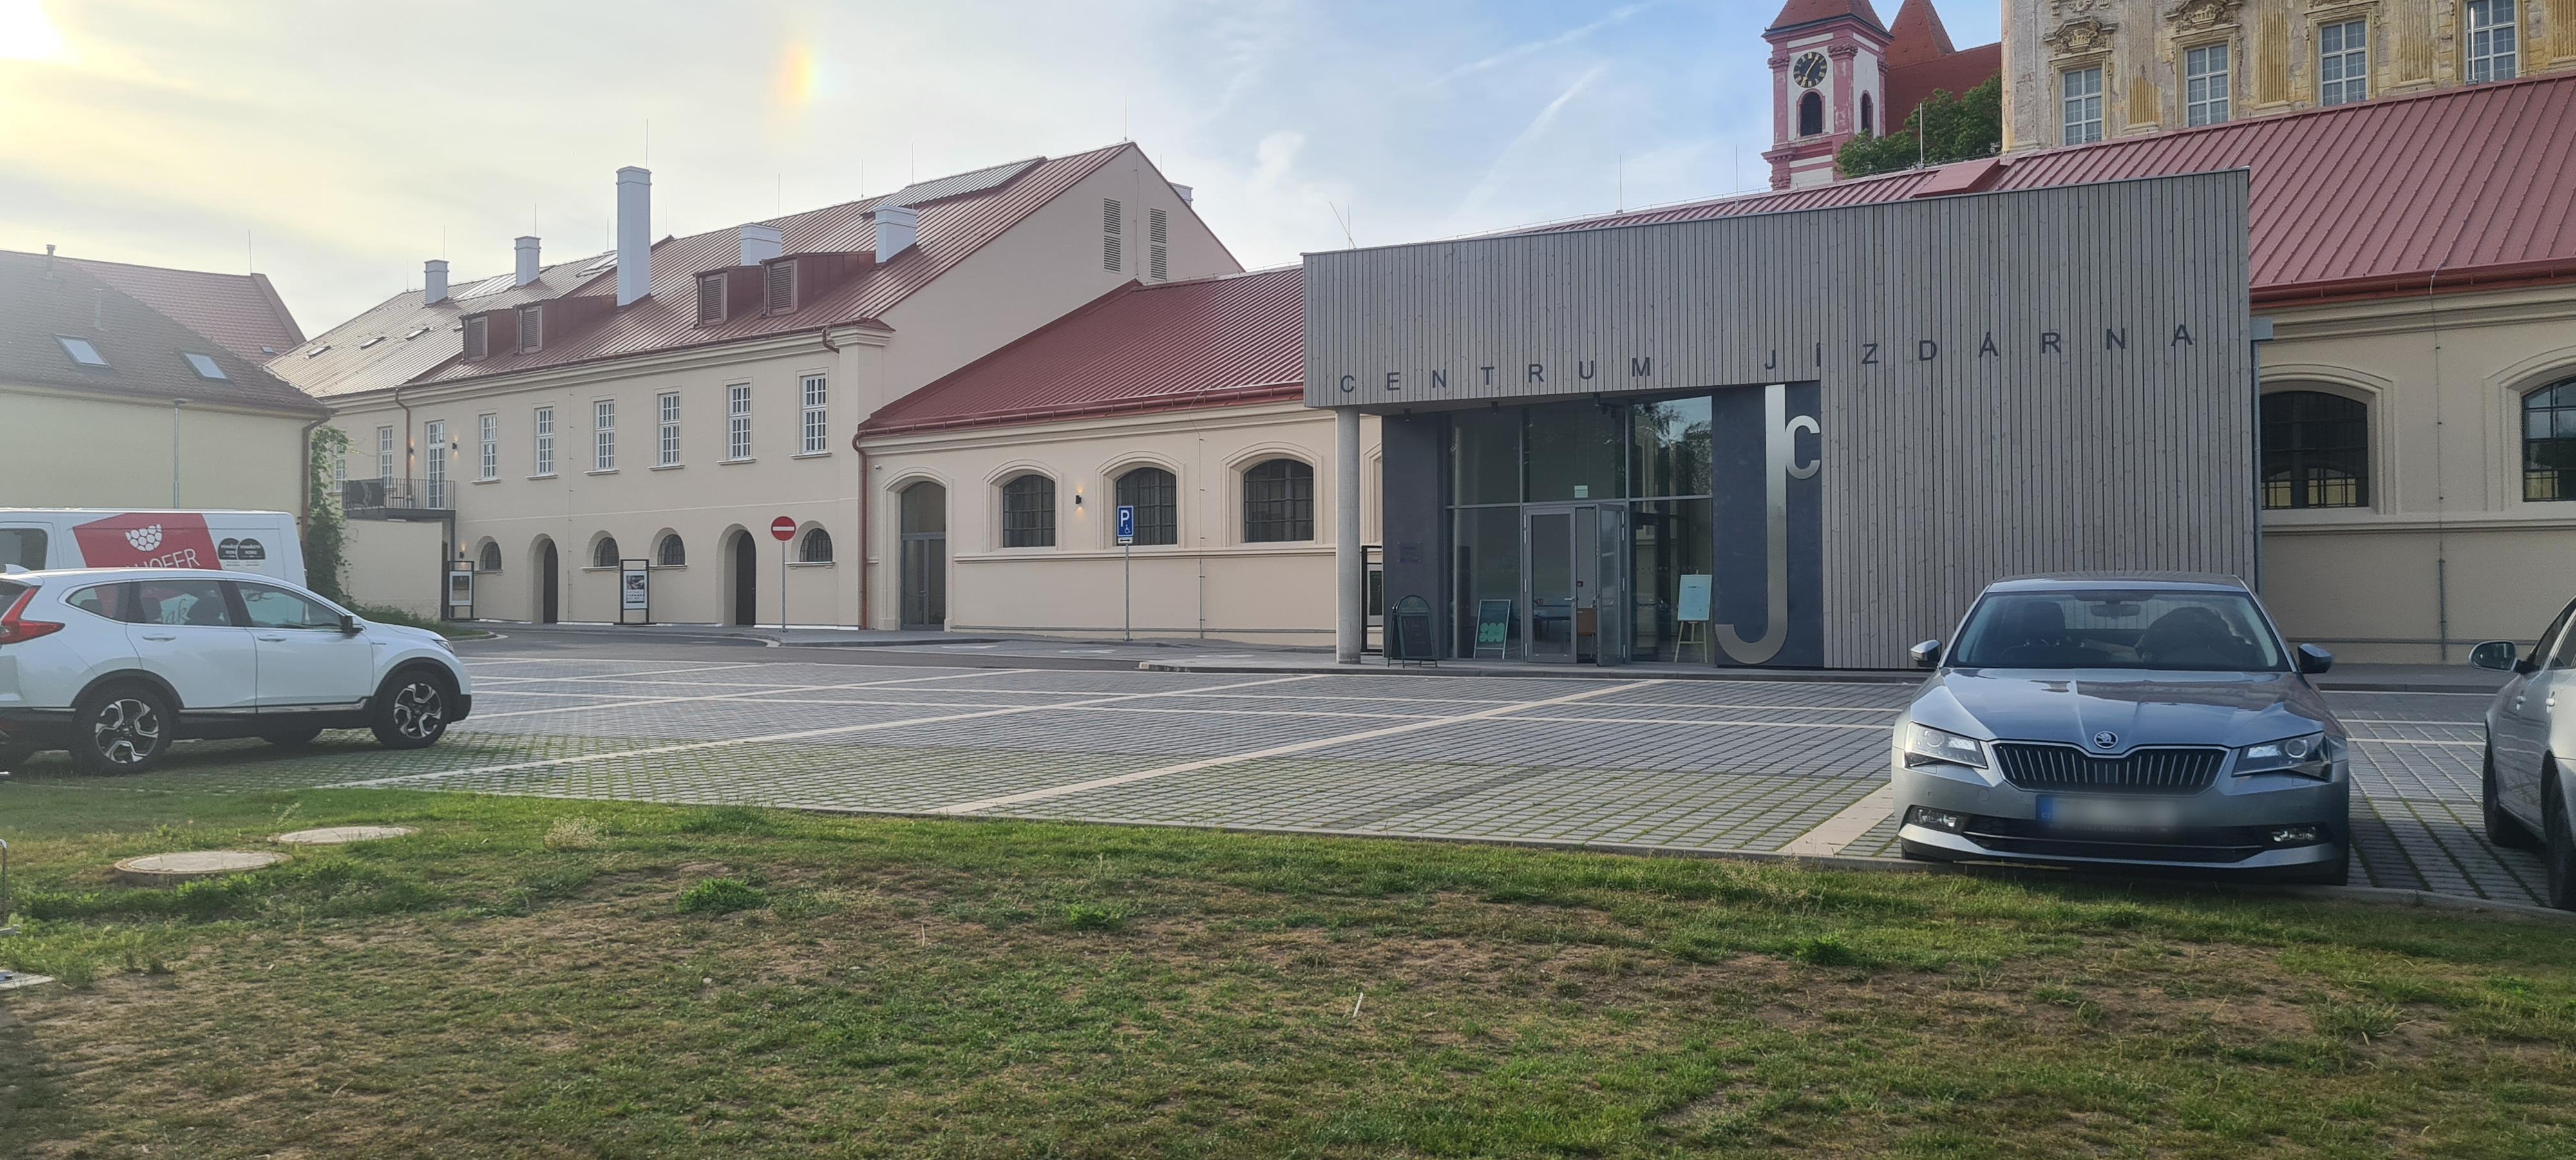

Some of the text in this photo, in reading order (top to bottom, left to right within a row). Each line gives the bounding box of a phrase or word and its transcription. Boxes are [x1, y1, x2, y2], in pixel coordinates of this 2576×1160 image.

[1340, 324, 2193, 392] CENTRUM JÍZDÁRNA
[1121, 509, 1130, 527] P
